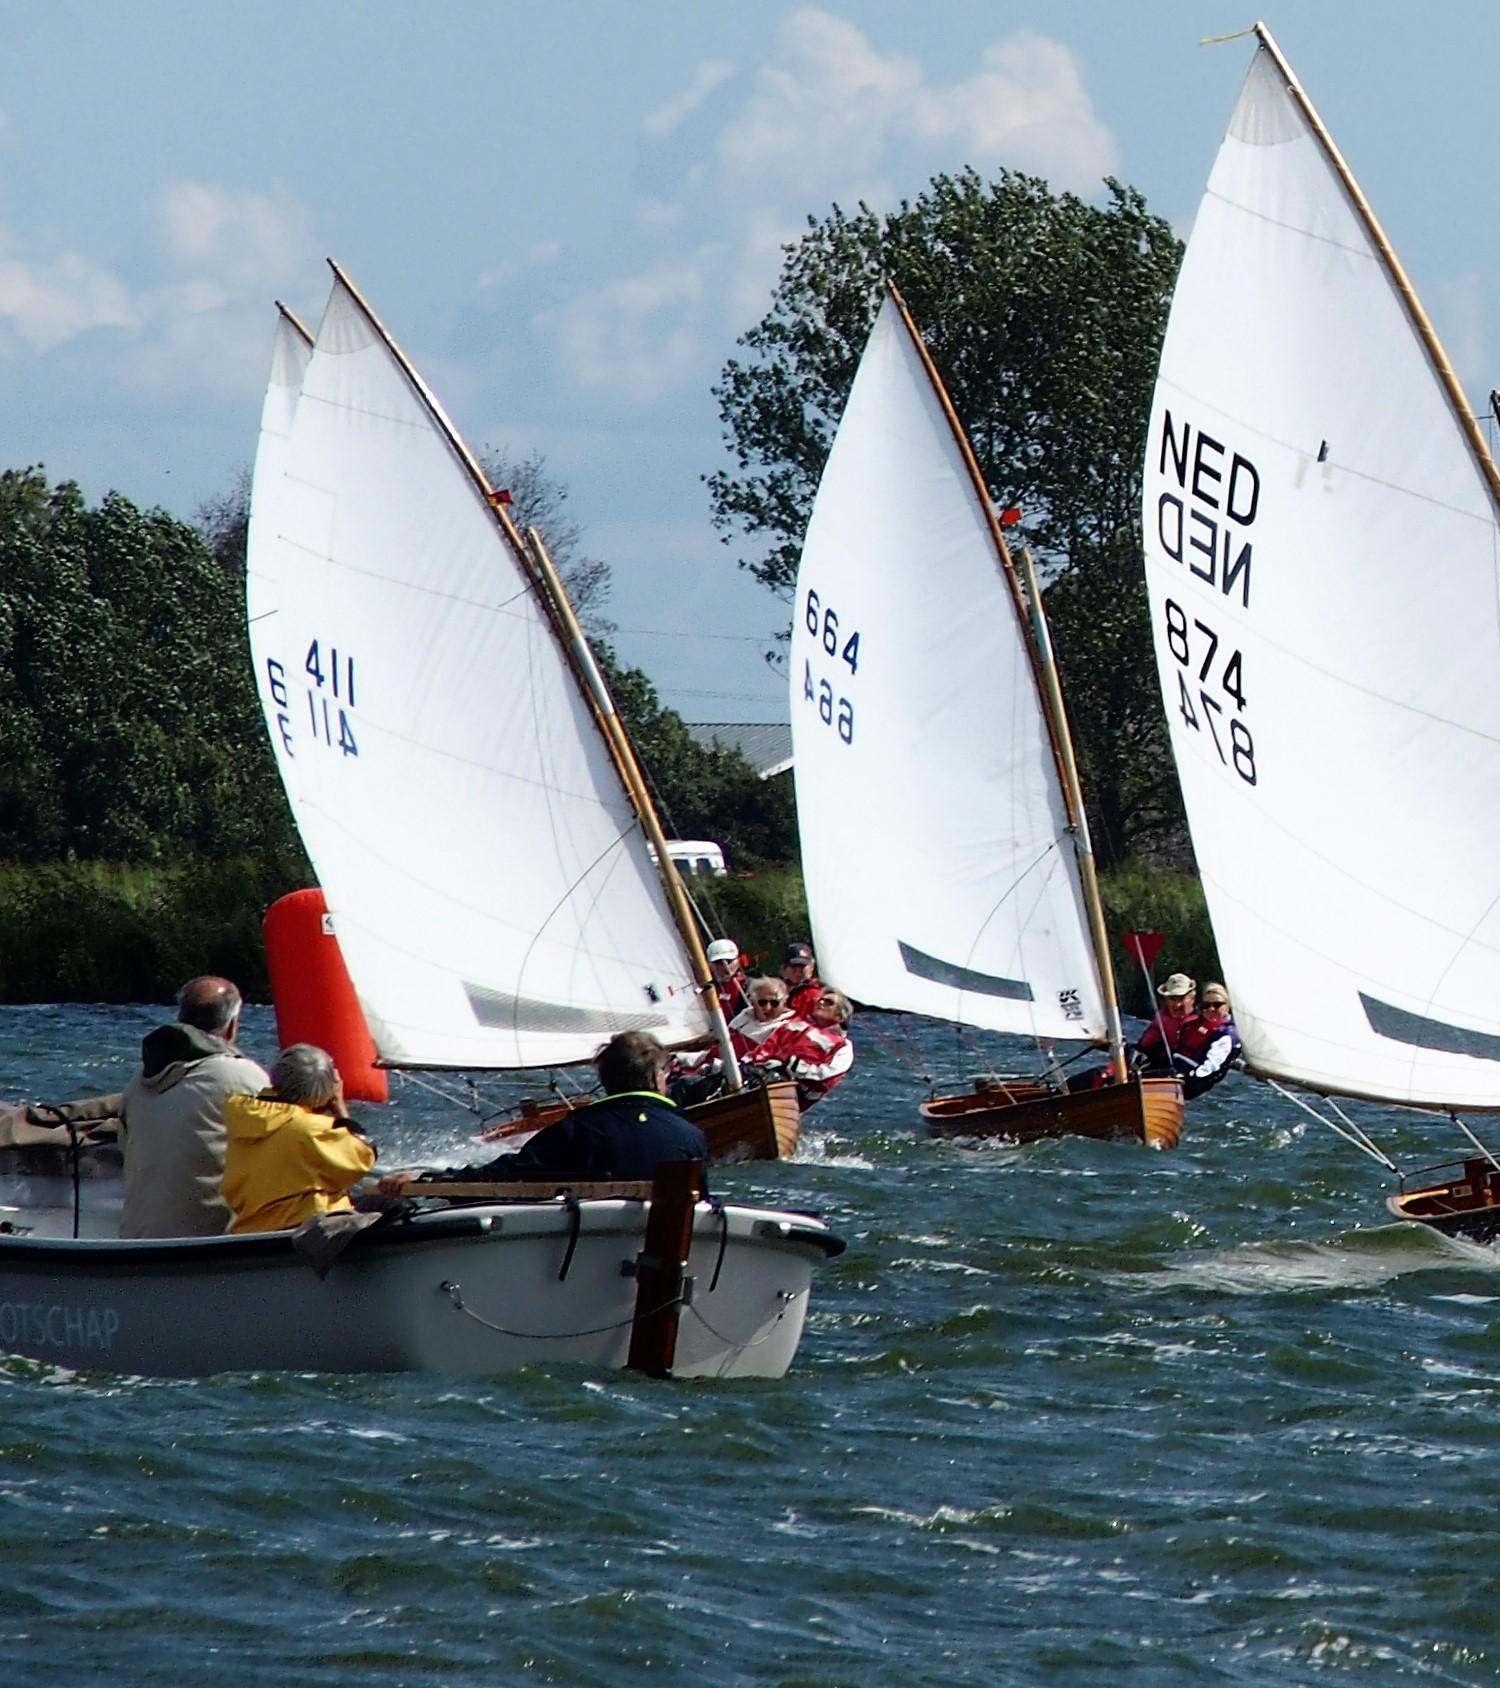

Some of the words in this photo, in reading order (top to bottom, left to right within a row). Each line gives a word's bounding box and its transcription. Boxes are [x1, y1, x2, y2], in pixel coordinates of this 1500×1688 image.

[1160, 409, 1260, 526] NED
[305, 639, 354, 707] 411
[806, 588, 860, 675] 664
[1165, 598, 1247, 712] 874
